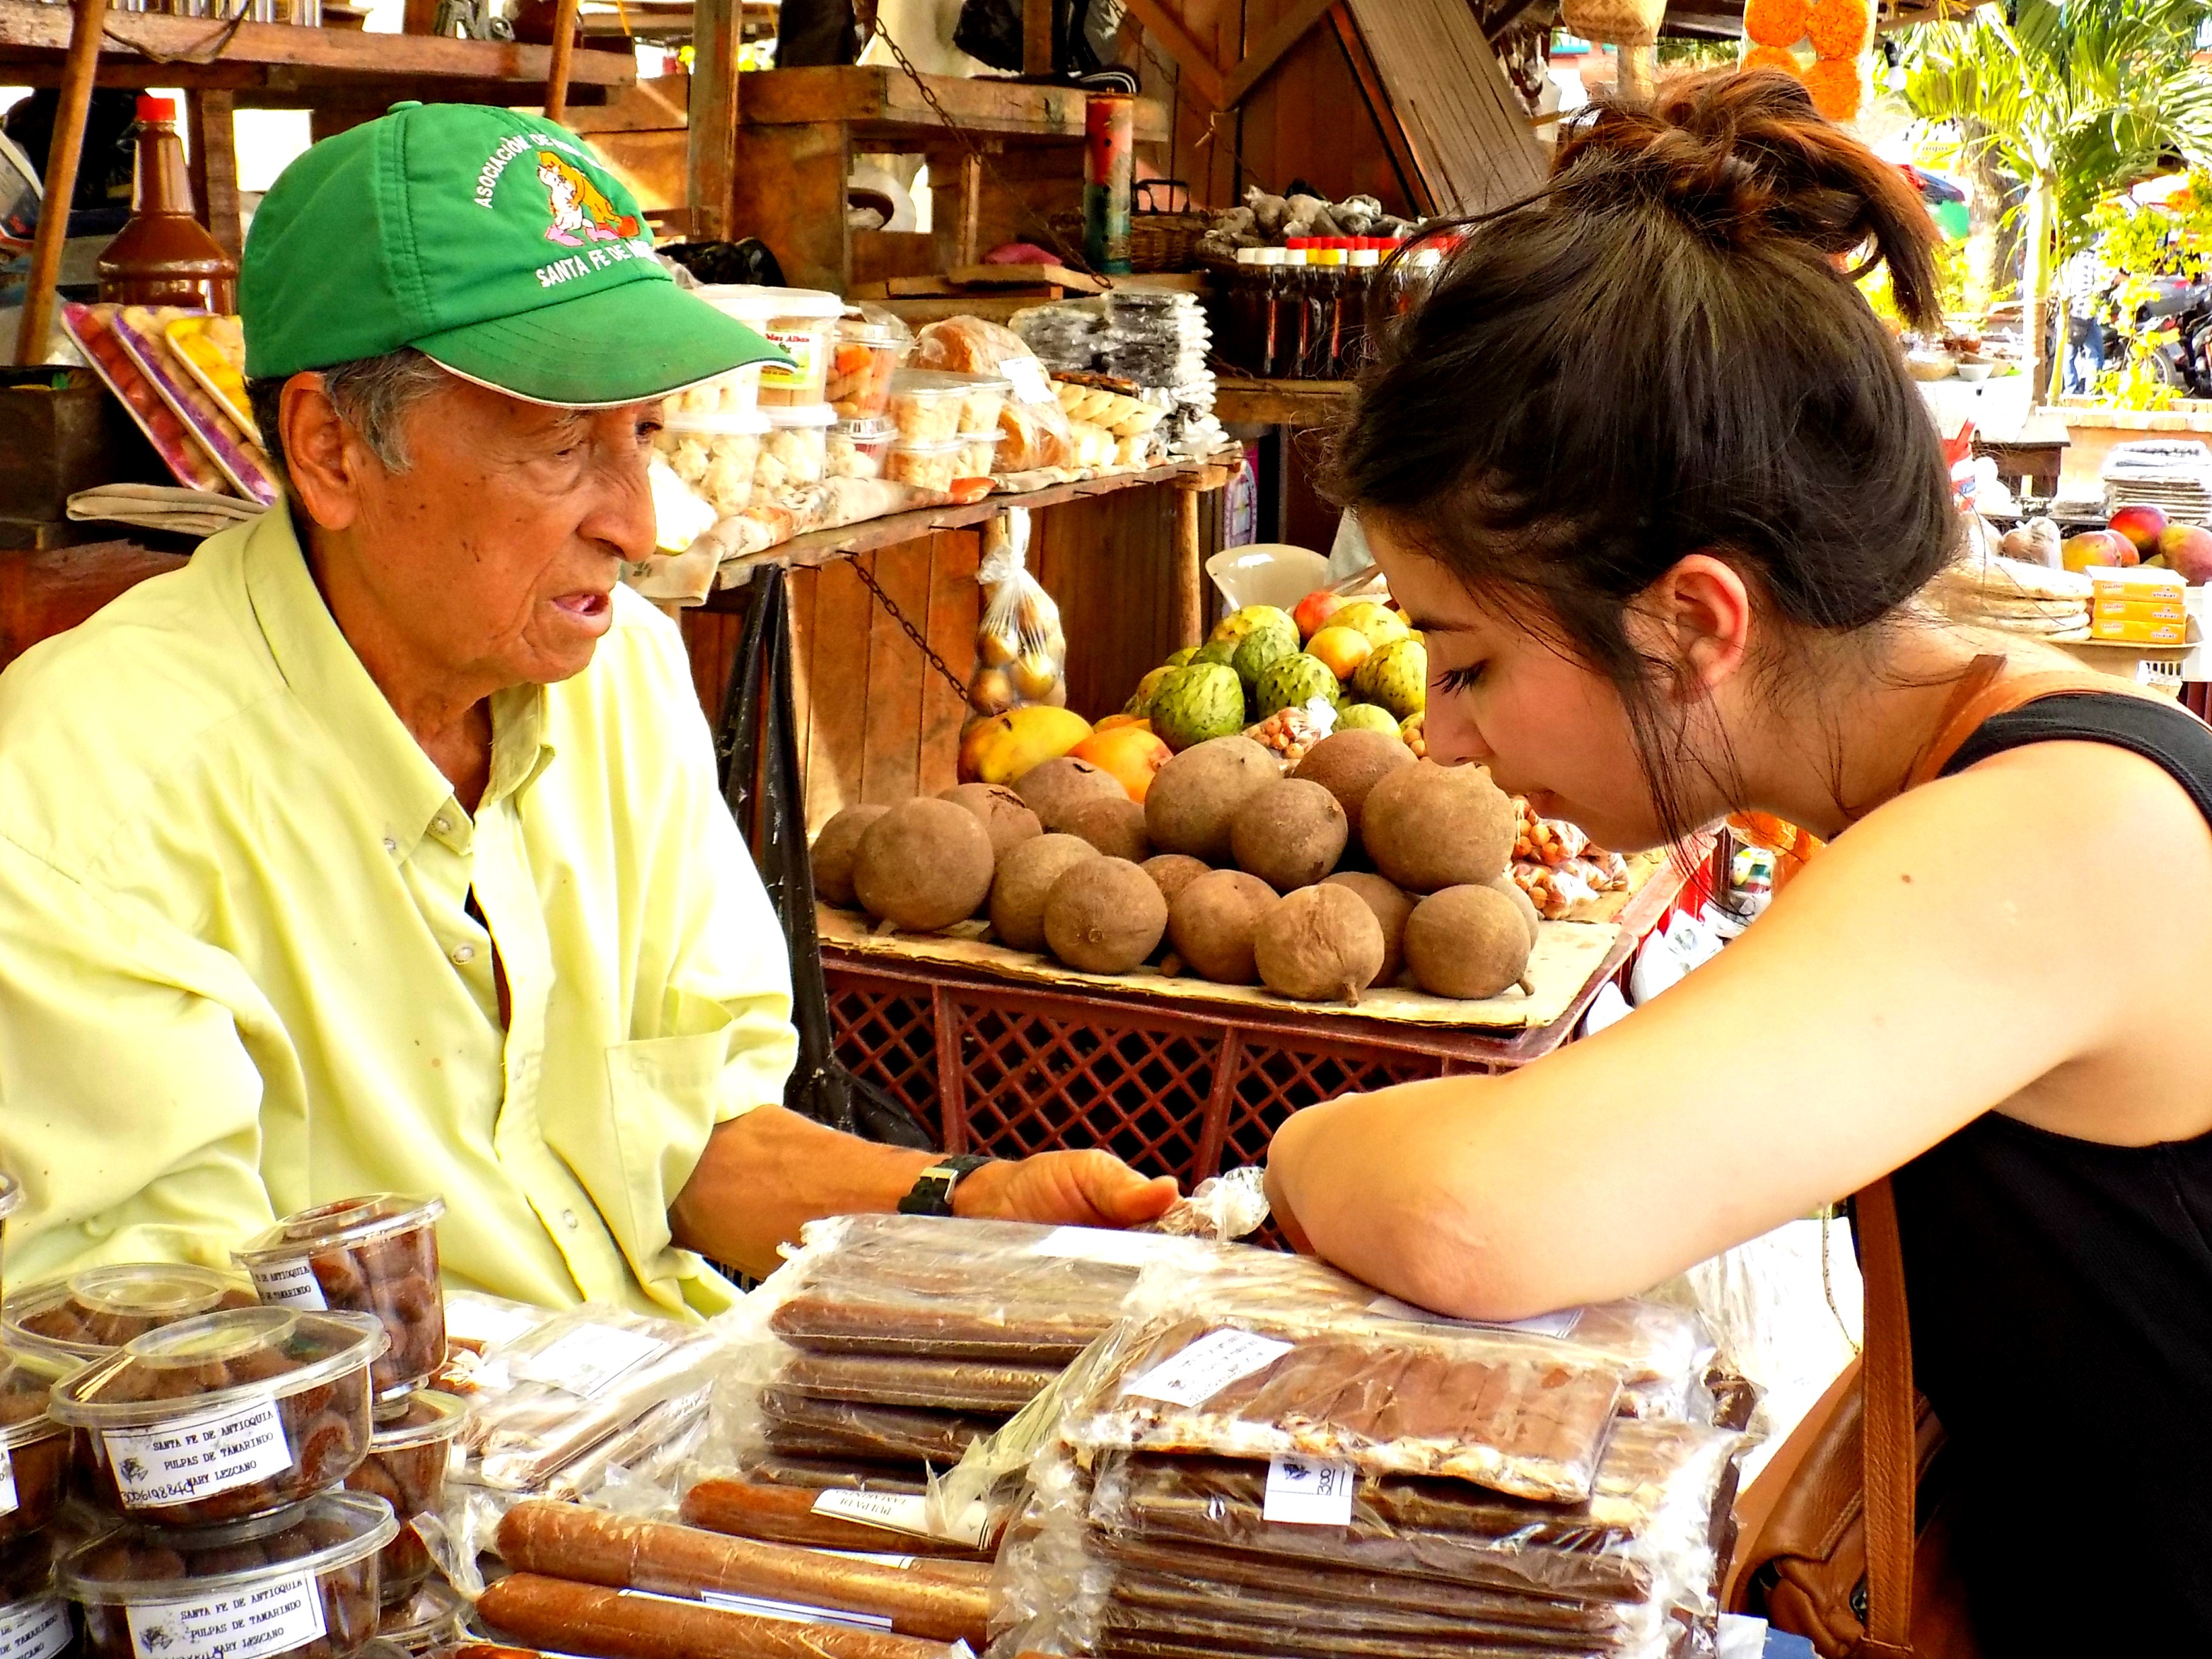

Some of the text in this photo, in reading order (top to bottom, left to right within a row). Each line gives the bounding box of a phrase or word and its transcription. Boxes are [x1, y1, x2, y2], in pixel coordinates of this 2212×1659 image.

[530, 133, 554, 146] DE
[535, 255, 590, 287] SANTA
[588, 250, 611, 271] FE
[605, 243, 631, 262] DE
[270, 1266, 310, 1281] ANTIOQUIA
[153, 1410, 274, 1451] SANTA FE DE ANTIOQUIA
[164, 1432, 274, 1470] PULPAS DE TAMARINDO
[214, 1460, 257, 1481] LEZCANO
[855, 1498, 892, 1515] PULPA
[180, 1580, 303, 1620] SANTA FE DE ANTIOQUIA
[191, 1599, 301, 1639] PULPAS DE TAMARINDO
[243, 1627, 284, 1648] LEZCANO
